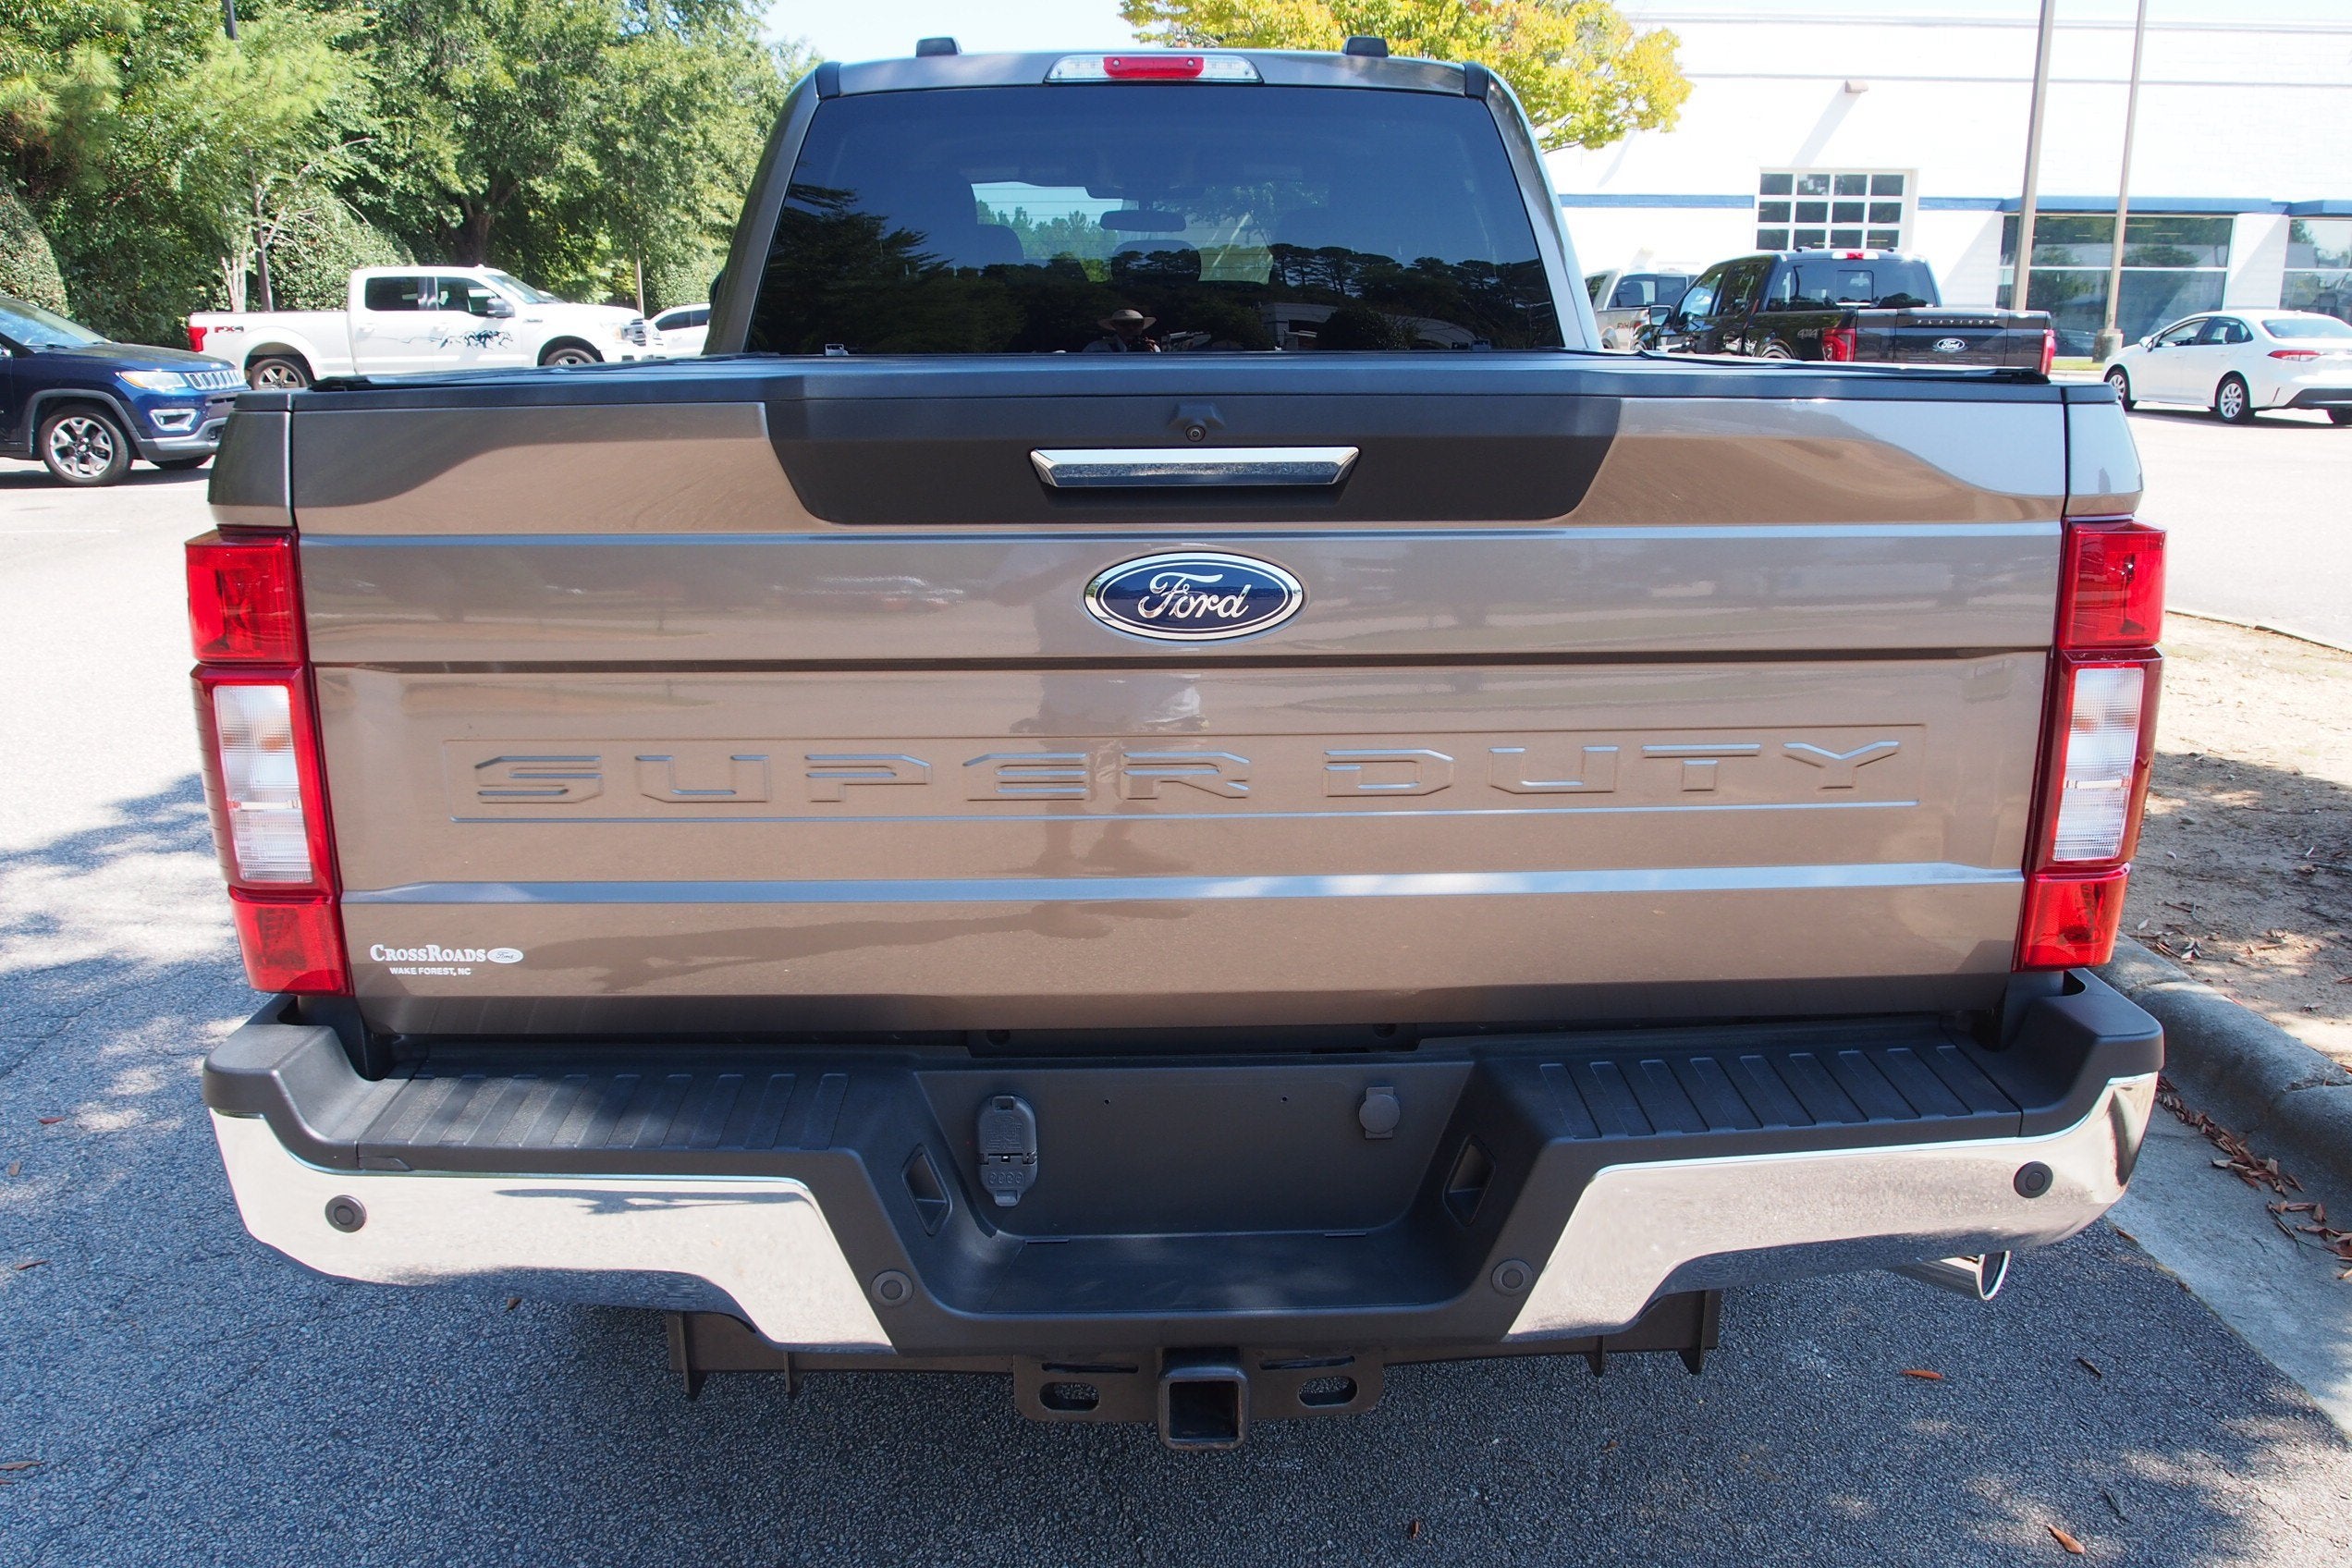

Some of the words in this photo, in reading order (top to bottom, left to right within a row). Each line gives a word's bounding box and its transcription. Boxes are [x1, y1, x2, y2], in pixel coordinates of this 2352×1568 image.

[214, 325, 244, 334] FX4
[1137, 571, 1252, 619] Ford
[473, 751, 1252, 804] SUPER
[1322, 740, 1901, 799] DUTY
[389, 967, 417, 975] WAKE
[418, 967, 456, 976] FOREST,
[458, 967, 472, 975] NC
